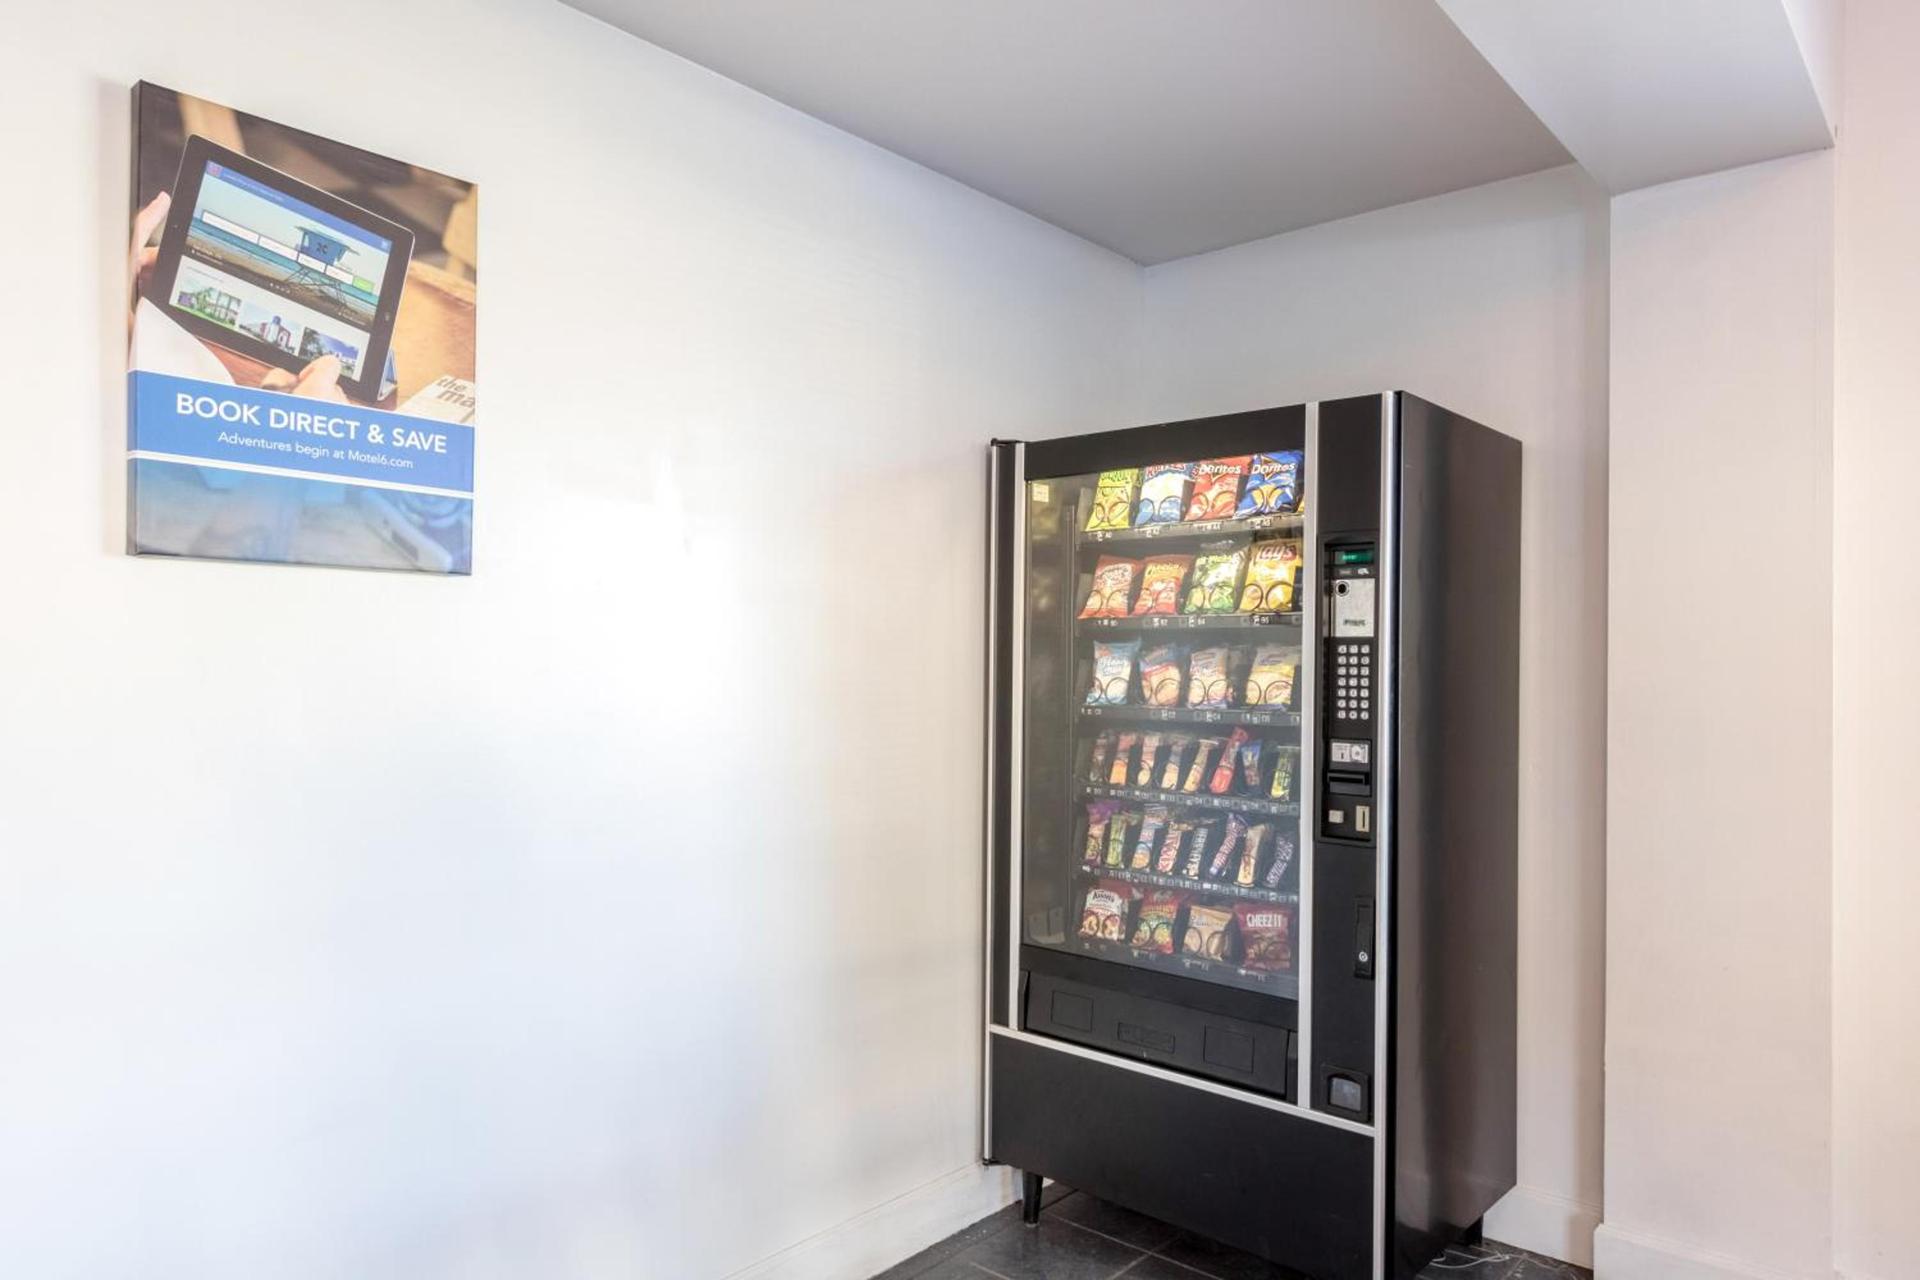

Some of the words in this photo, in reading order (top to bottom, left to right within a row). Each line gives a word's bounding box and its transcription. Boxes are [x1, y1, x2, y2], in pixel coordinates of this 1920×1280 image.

[176, 391, 262, 426] BOOK
[269, 407, 361, 440] DIRECT
[367, 423, 386, 445] &
[392, 427, 448, 454] SAVE
[217, 431, 293, 453] Adventures
[295, 441, 330, 460] begin
[333, 448, 345, 460] at
[348, 449, 414, 469] Motel6.com
[1199, 462, 1242, 475] Doritos
[1251, 461, 1296, 475] Doritos
